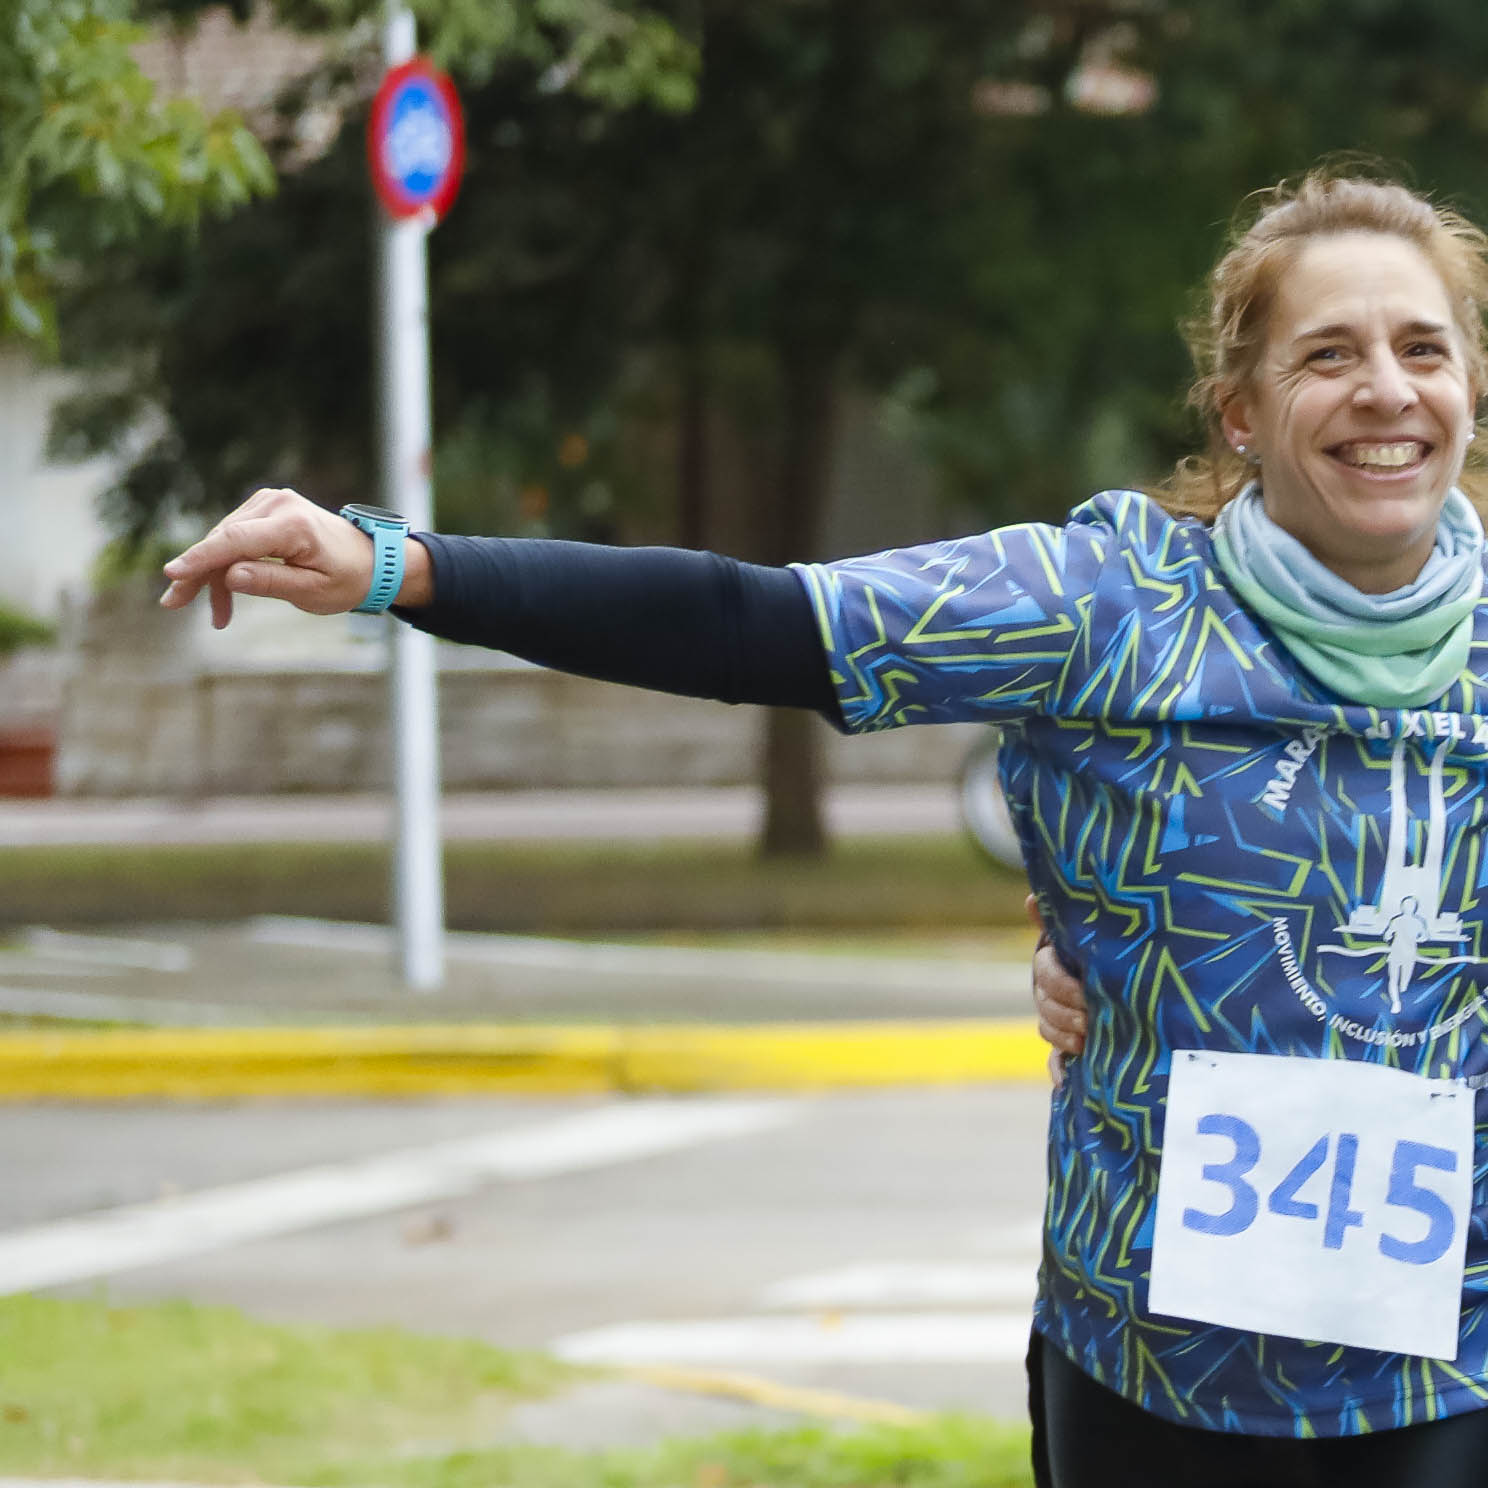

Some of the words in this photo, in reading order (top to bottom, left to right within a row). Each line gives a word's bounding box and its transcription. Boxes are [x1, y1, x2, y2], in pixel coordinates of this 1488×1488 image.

[1402, 710, 1428, 738] X
[1434, 712, 1467, 740] EL
[1181, 1111, 1460, 1266] 345
